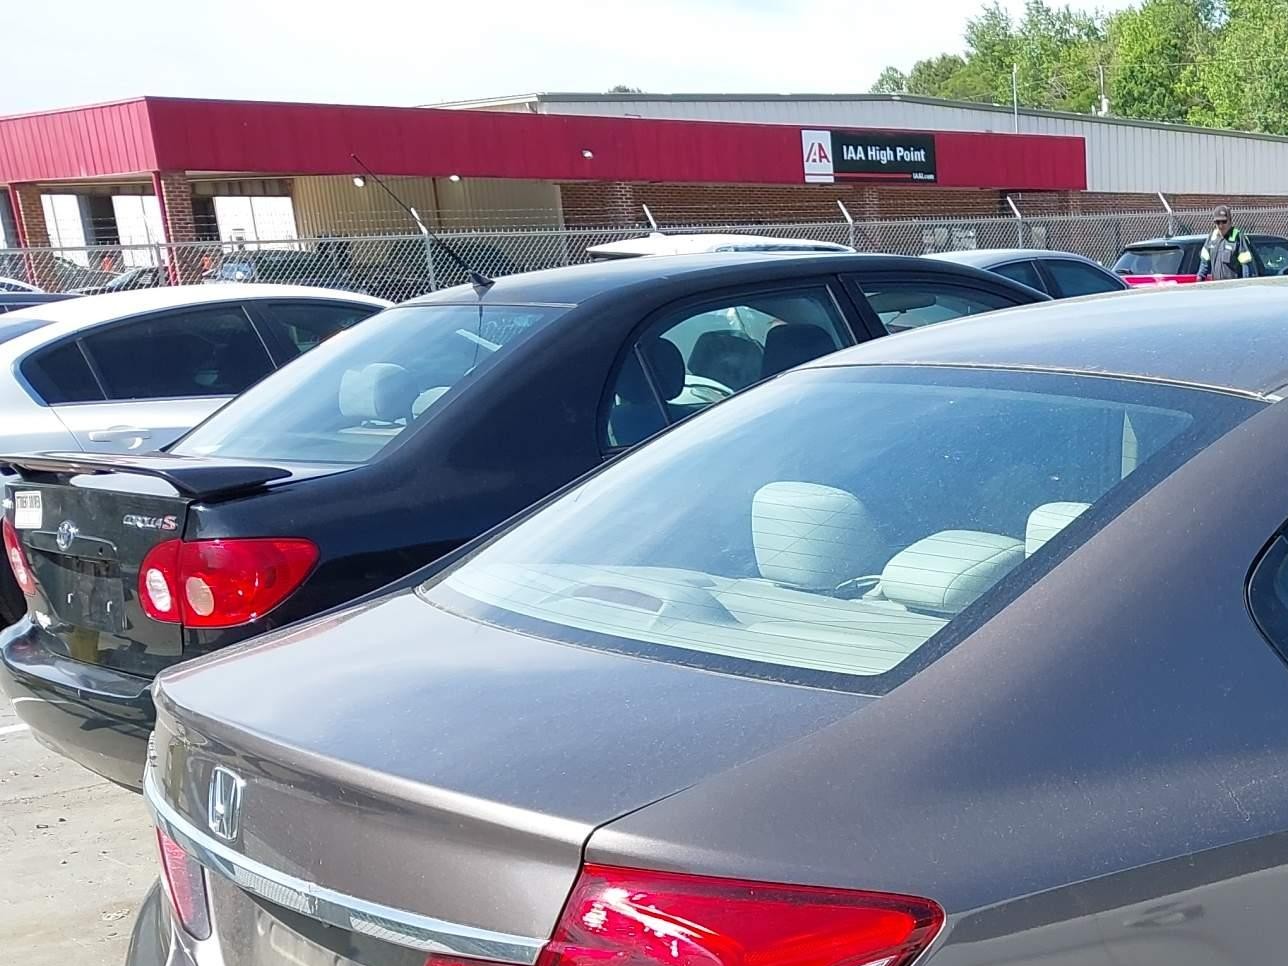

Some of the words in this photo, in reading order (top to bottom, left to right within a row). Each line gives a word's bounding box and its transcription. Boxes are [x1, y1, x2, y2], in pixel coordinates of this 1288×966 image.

[843, 145, 865, 160] IAA
[868, 146, 894, 164] High
[896, 147, 926, 162] Point
[162, 515, 177, 530] S
